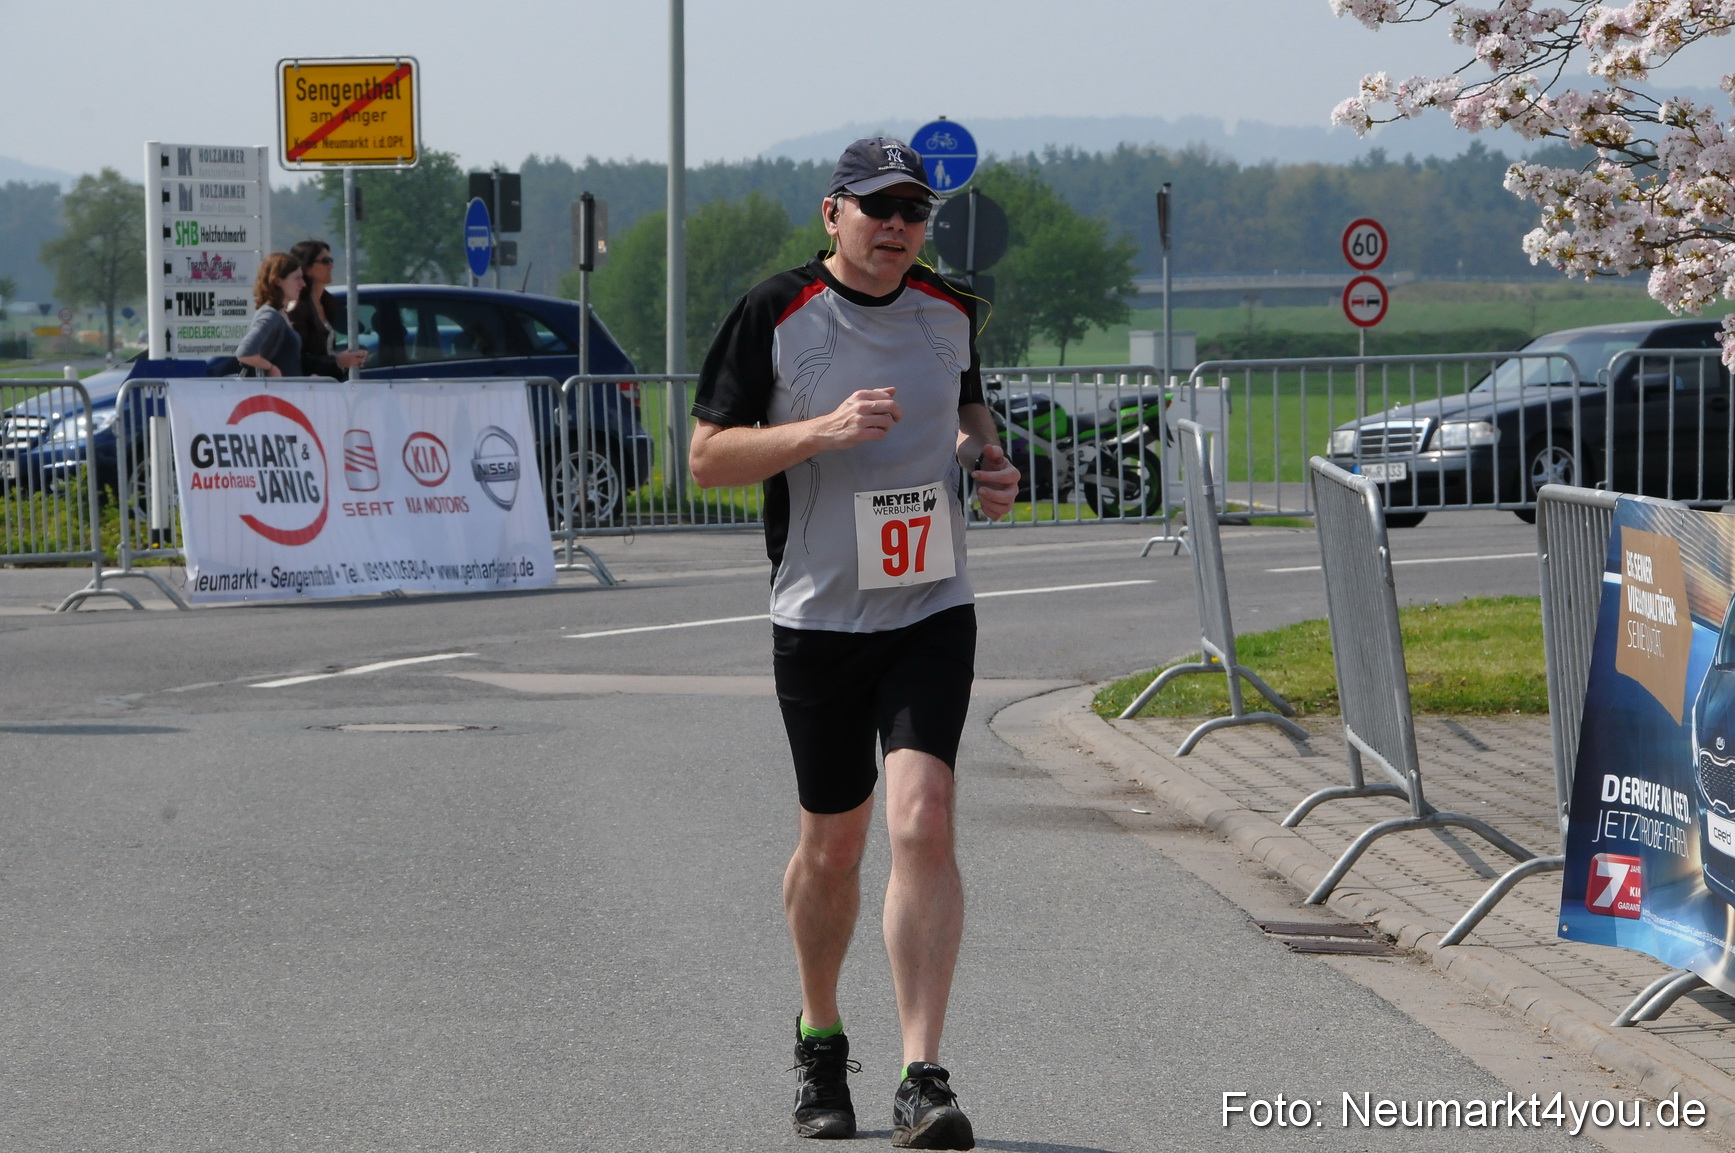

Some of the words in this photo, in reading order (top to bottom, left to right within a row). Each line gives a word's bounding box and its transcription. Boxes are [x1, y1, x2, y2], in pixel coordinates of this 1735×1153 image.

[296, 76, 402, 107] Sengenthal
[310, 112, 333, 123] am
[341, 108, 387, 126] Anger
[294, 137, 318, 149] Kreis
[322, 137, 368, 149] Neumarkt
[199, 148, 245, 164] HOLZAMMER
[200, 183, 246, 199] HOLZAMMER
[175, 220, 199, 247] SHB
[200, 225, 246, 243] Holzfachmarkt
[1352, 233, 1378, 256] 60
[176, 292, 215, 316] THULE
[190, 434, 299, 469] GERHART
[301, 443, 310, 461] &
[411, 446, 443, 473] KIA
[191, 471, 257, 490] Autohaus
[256, 470, 320, 504] JÄNIG
[342, 501, 394, 517] SEAT
[405, 496, 422, 514] KIA
[425, 496, 470, 515] MOTORS
[872, 492, 920, 507] MEYER
[873, 504, 921, 516] WERBUNG
[881, 515, 932, 577] 97
[194, 568, 259, 592] eumarkt
[270, 565, 336, 593] Sengenthal
[1601, 774, 1640, 806] DER
[1661, 785, 1673, 817] KIA
[1592, 861, 1631, 907] 7
